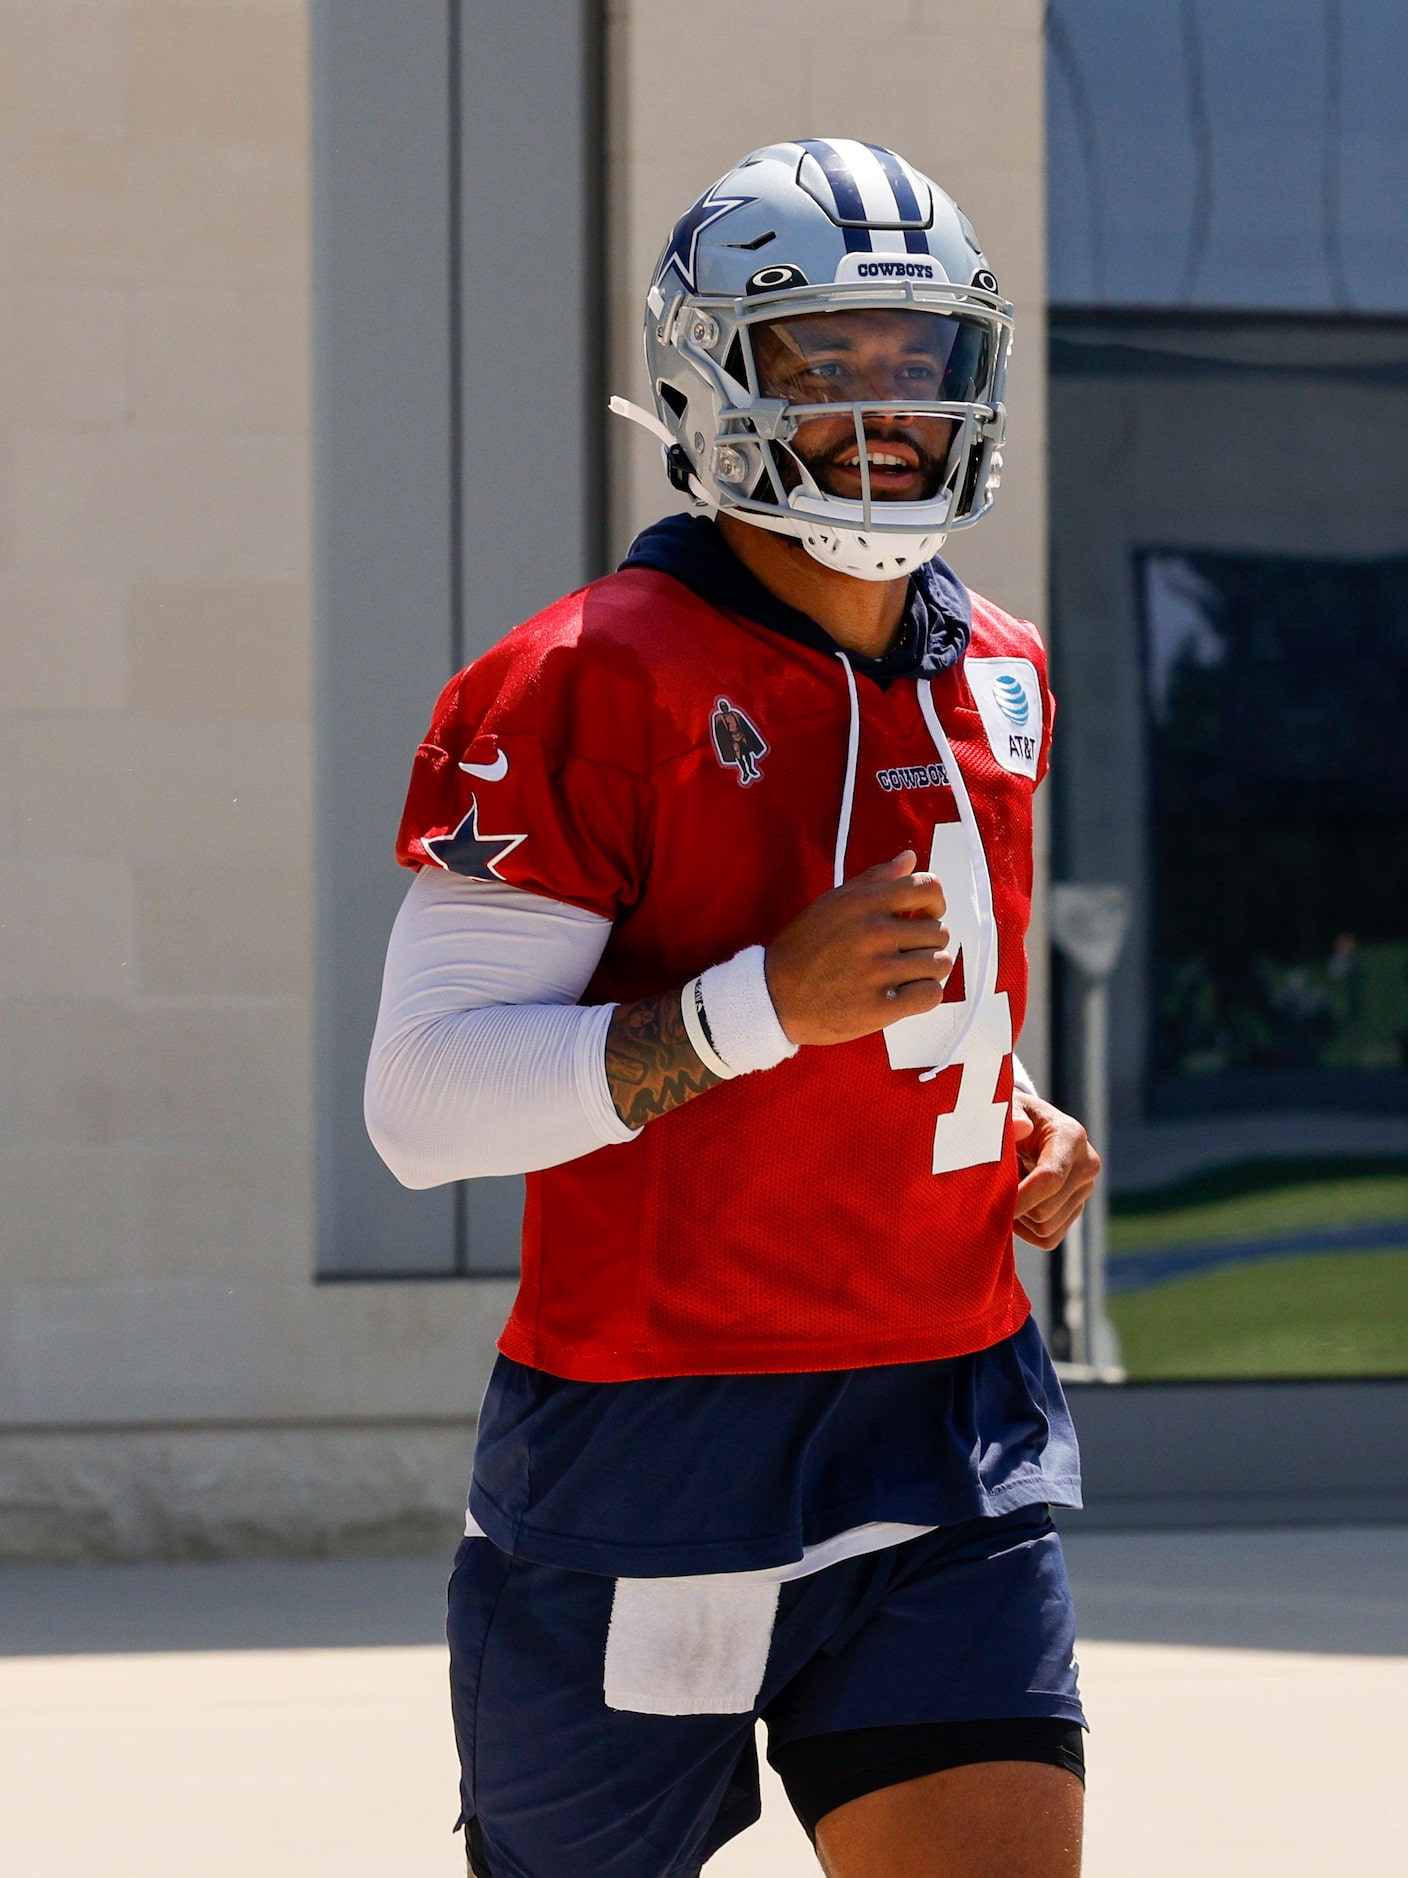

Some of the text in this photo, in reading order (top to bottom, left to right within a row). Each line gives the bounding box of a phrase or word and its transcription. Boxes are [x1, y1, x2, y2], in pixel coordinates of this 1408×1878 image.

[857, 262, 934, 279] COWBOYS
[1008, 734, 1036, 761] AT&T
[876, 763, 952, 792] COWBOY
[883, 821, 1013, 1175] 4
